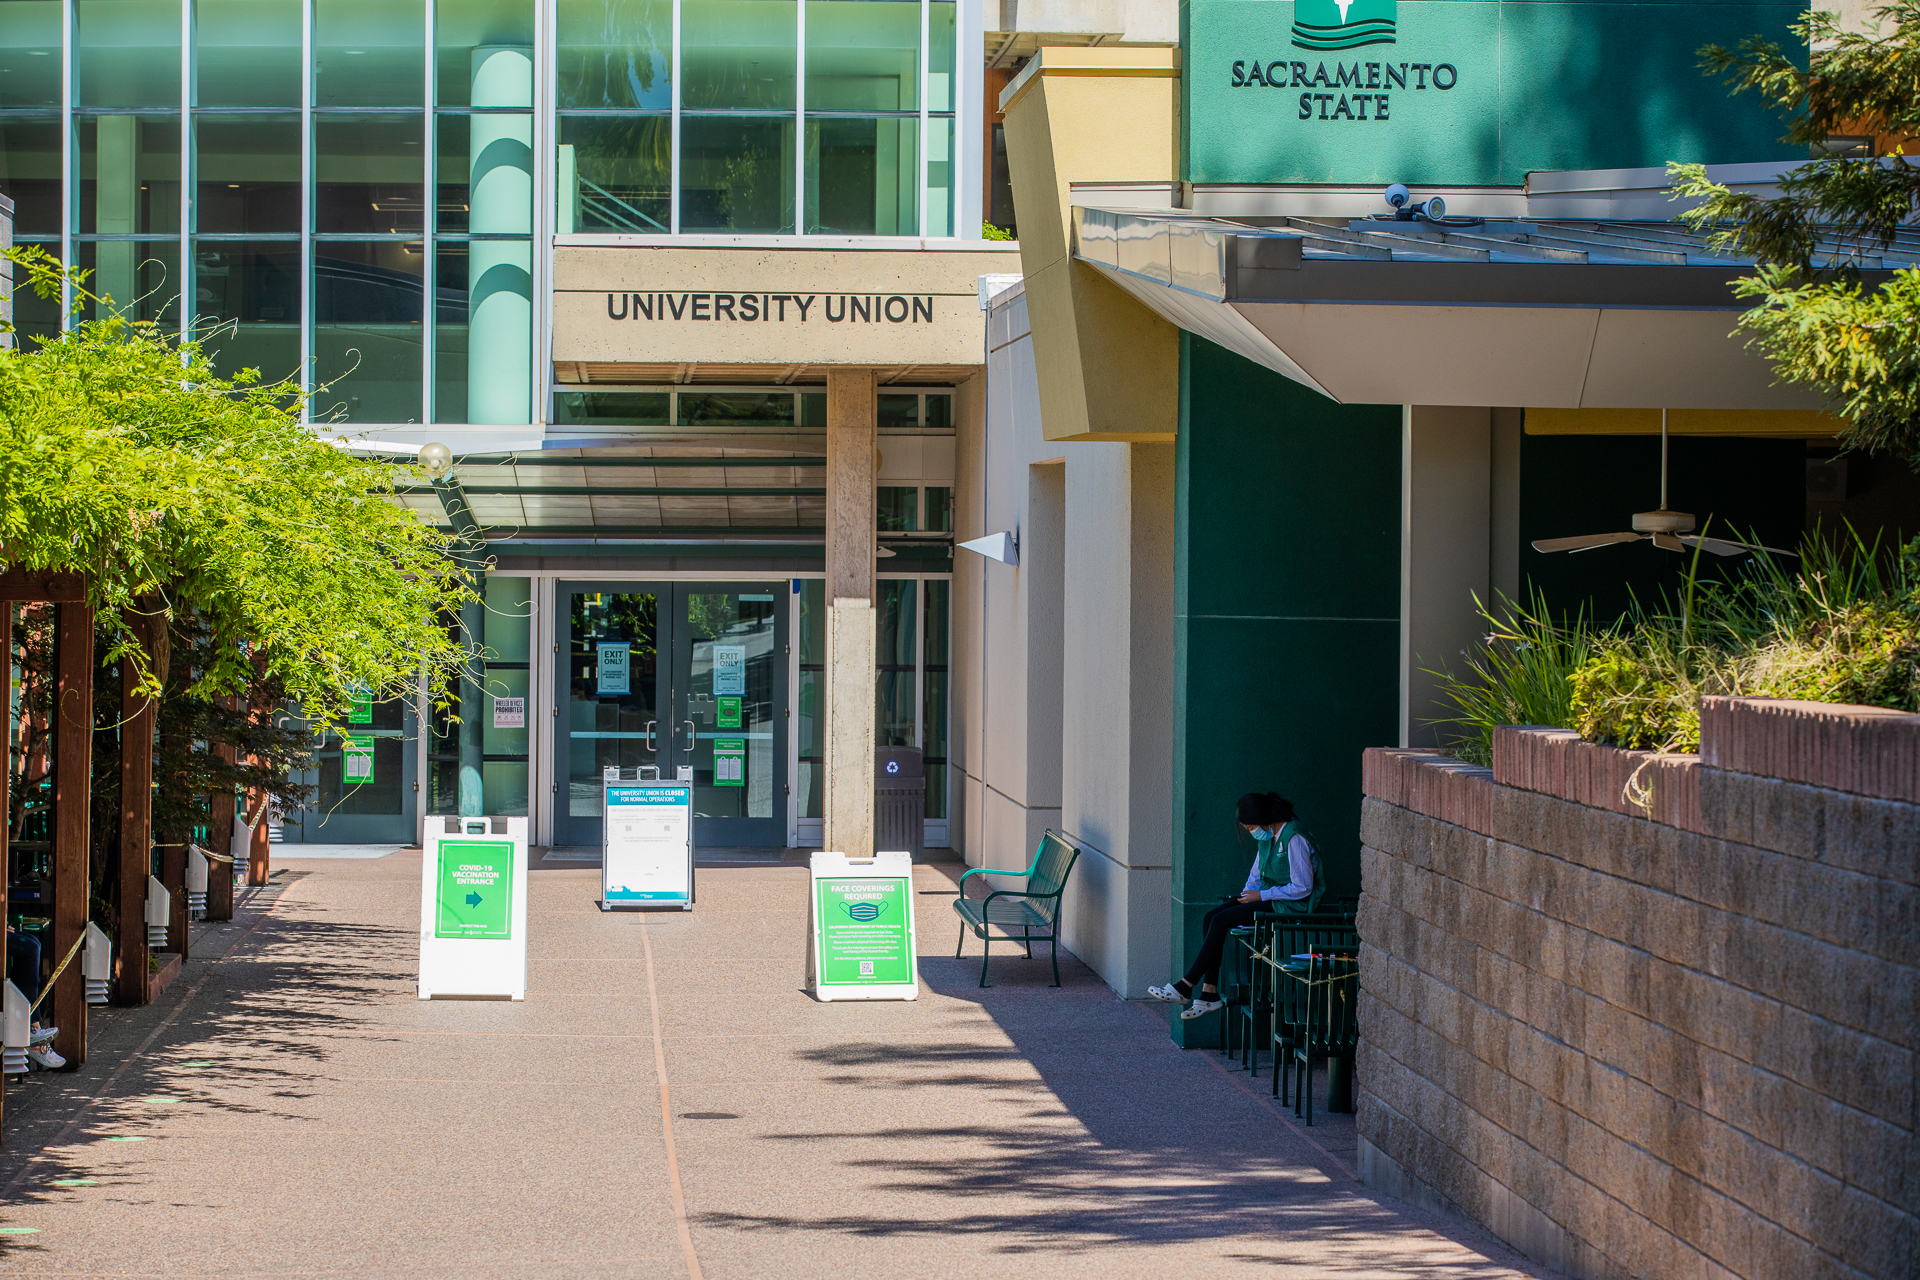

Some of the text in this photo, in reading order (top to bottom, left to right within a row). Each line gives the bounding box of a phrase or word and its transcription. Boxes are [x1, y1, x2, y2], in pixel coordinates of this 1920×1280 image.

[1231, 60, 1458, 90] SACRAMENTO
[1298, 92, 1390, 120] STATE
[607, 293, 934, 324] UNIVERSITY UNION
